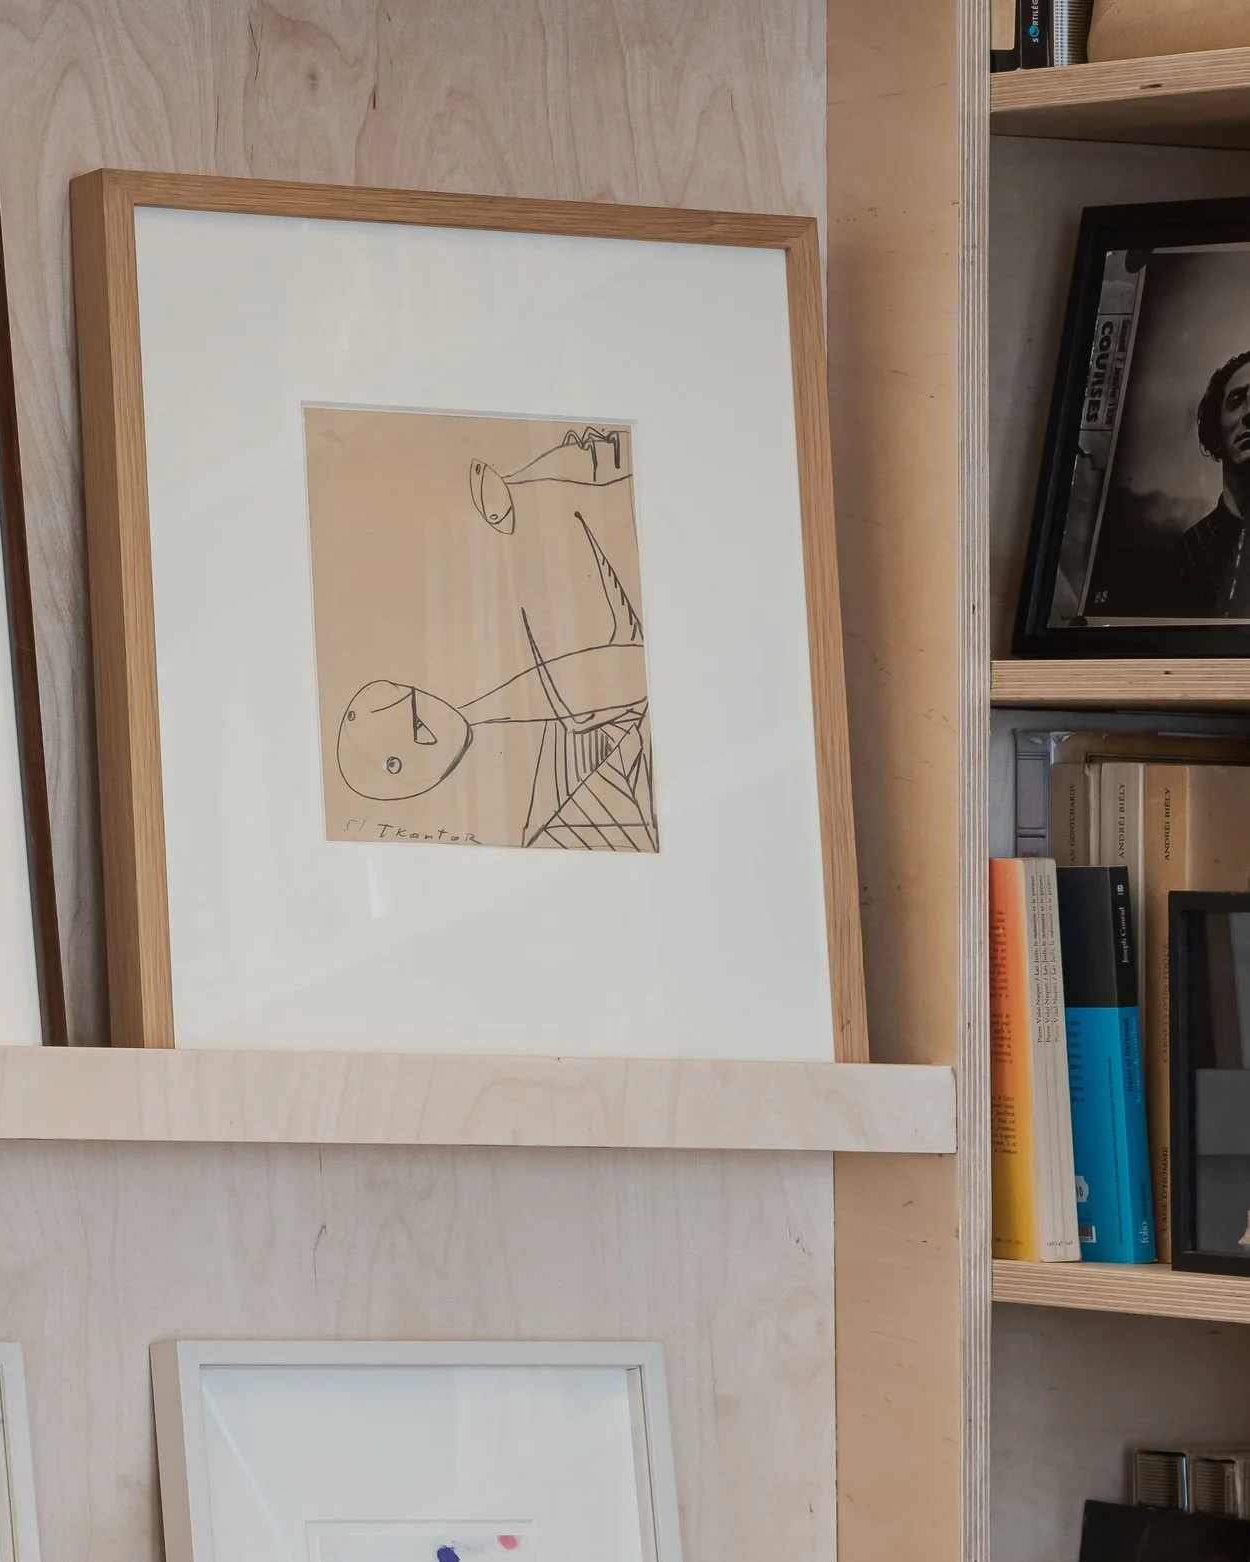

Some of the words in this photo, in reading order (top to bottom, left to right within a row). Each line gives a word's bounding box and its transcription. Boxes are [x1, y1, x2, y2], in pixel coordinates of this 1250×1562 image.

[1086, 321, 1114, 423] COURSES
[1117, 782, 1125, 813] BIÉLY
[1162, 787, 1170, 818] BIÉLY
[1117, 816, 1125, 859] ANDRÉI
[1162, 821, 1170, 861] ANDRÉI
[1118, 907, 1126, 936] Conrad
[1121, 938, 1130, 964] Joseph
[1139, 1221, 1150, 1245] folio
